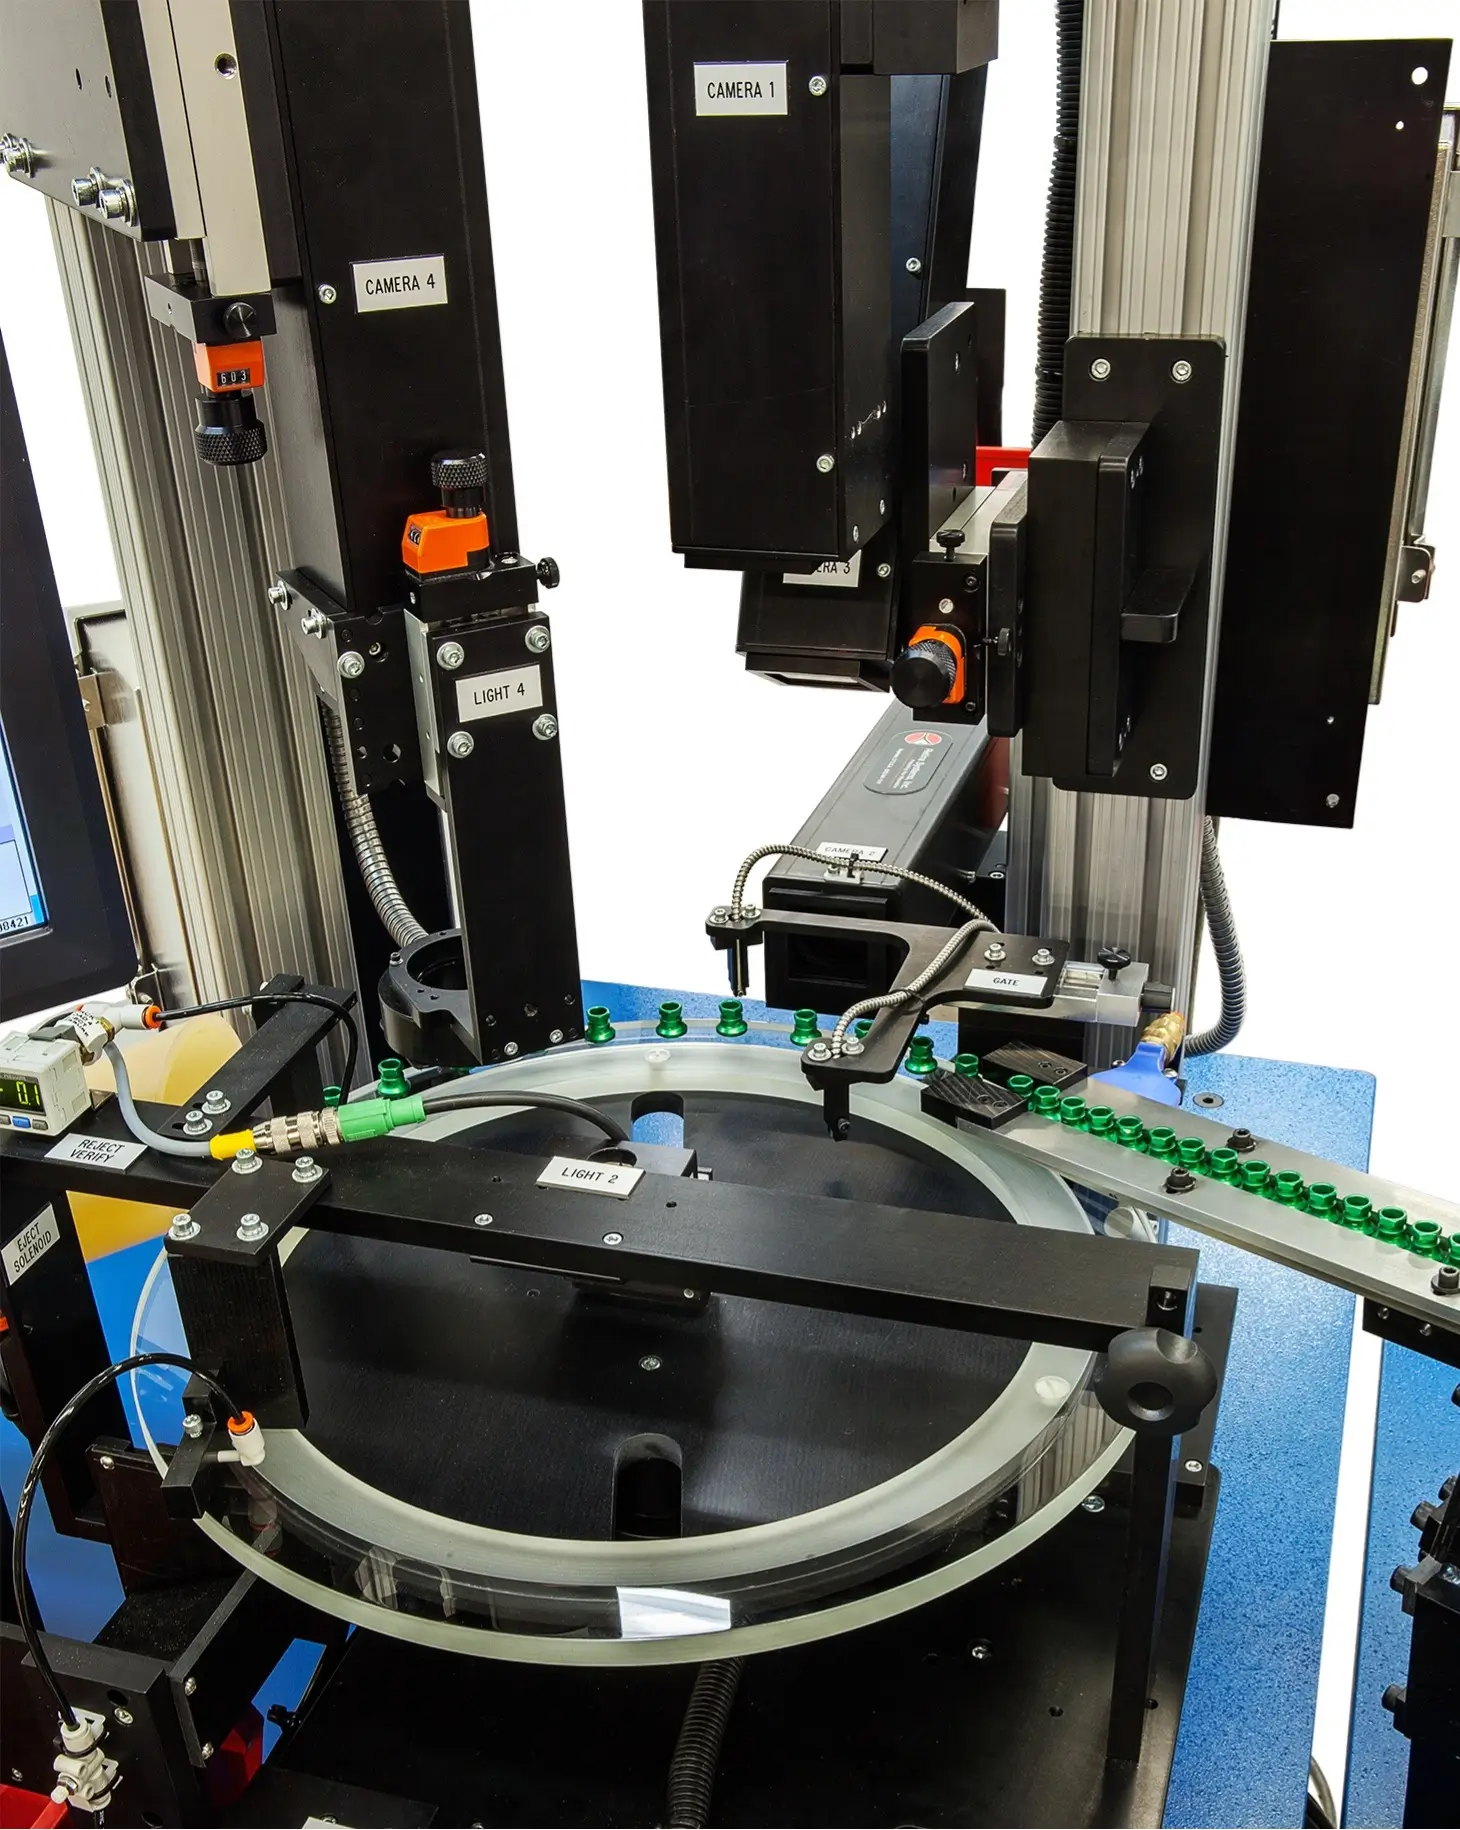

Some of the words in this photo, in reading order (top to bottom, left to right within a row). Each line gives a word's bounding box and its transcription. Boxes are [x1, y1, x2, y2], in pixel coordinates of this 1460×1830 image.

[707, 81, 763, 99] CAMERA
[769, 81, 775, 98] 1
[365, 275, 421, 295] CAMERA
[426, 273, 436, 289] 4
[220, 370, 247, 384] 603
[473, 685, 510, 705] LIGHT
[517, 682, 526, 696] 4
[824, 846, 864, 856] CAMERA
[992, 977, 1020, 987] GATE
[78, 1139, 125, 1154] REJECT
[70, 1149, 115, 1163] VERIFY
[561, 1167, 605, 1182] LIGHT
[608, 1174, 619, 1184] 2
[17, 1222, 40, 1252] EJECT
[13, 1230, 52, 1273] SOLENOID
